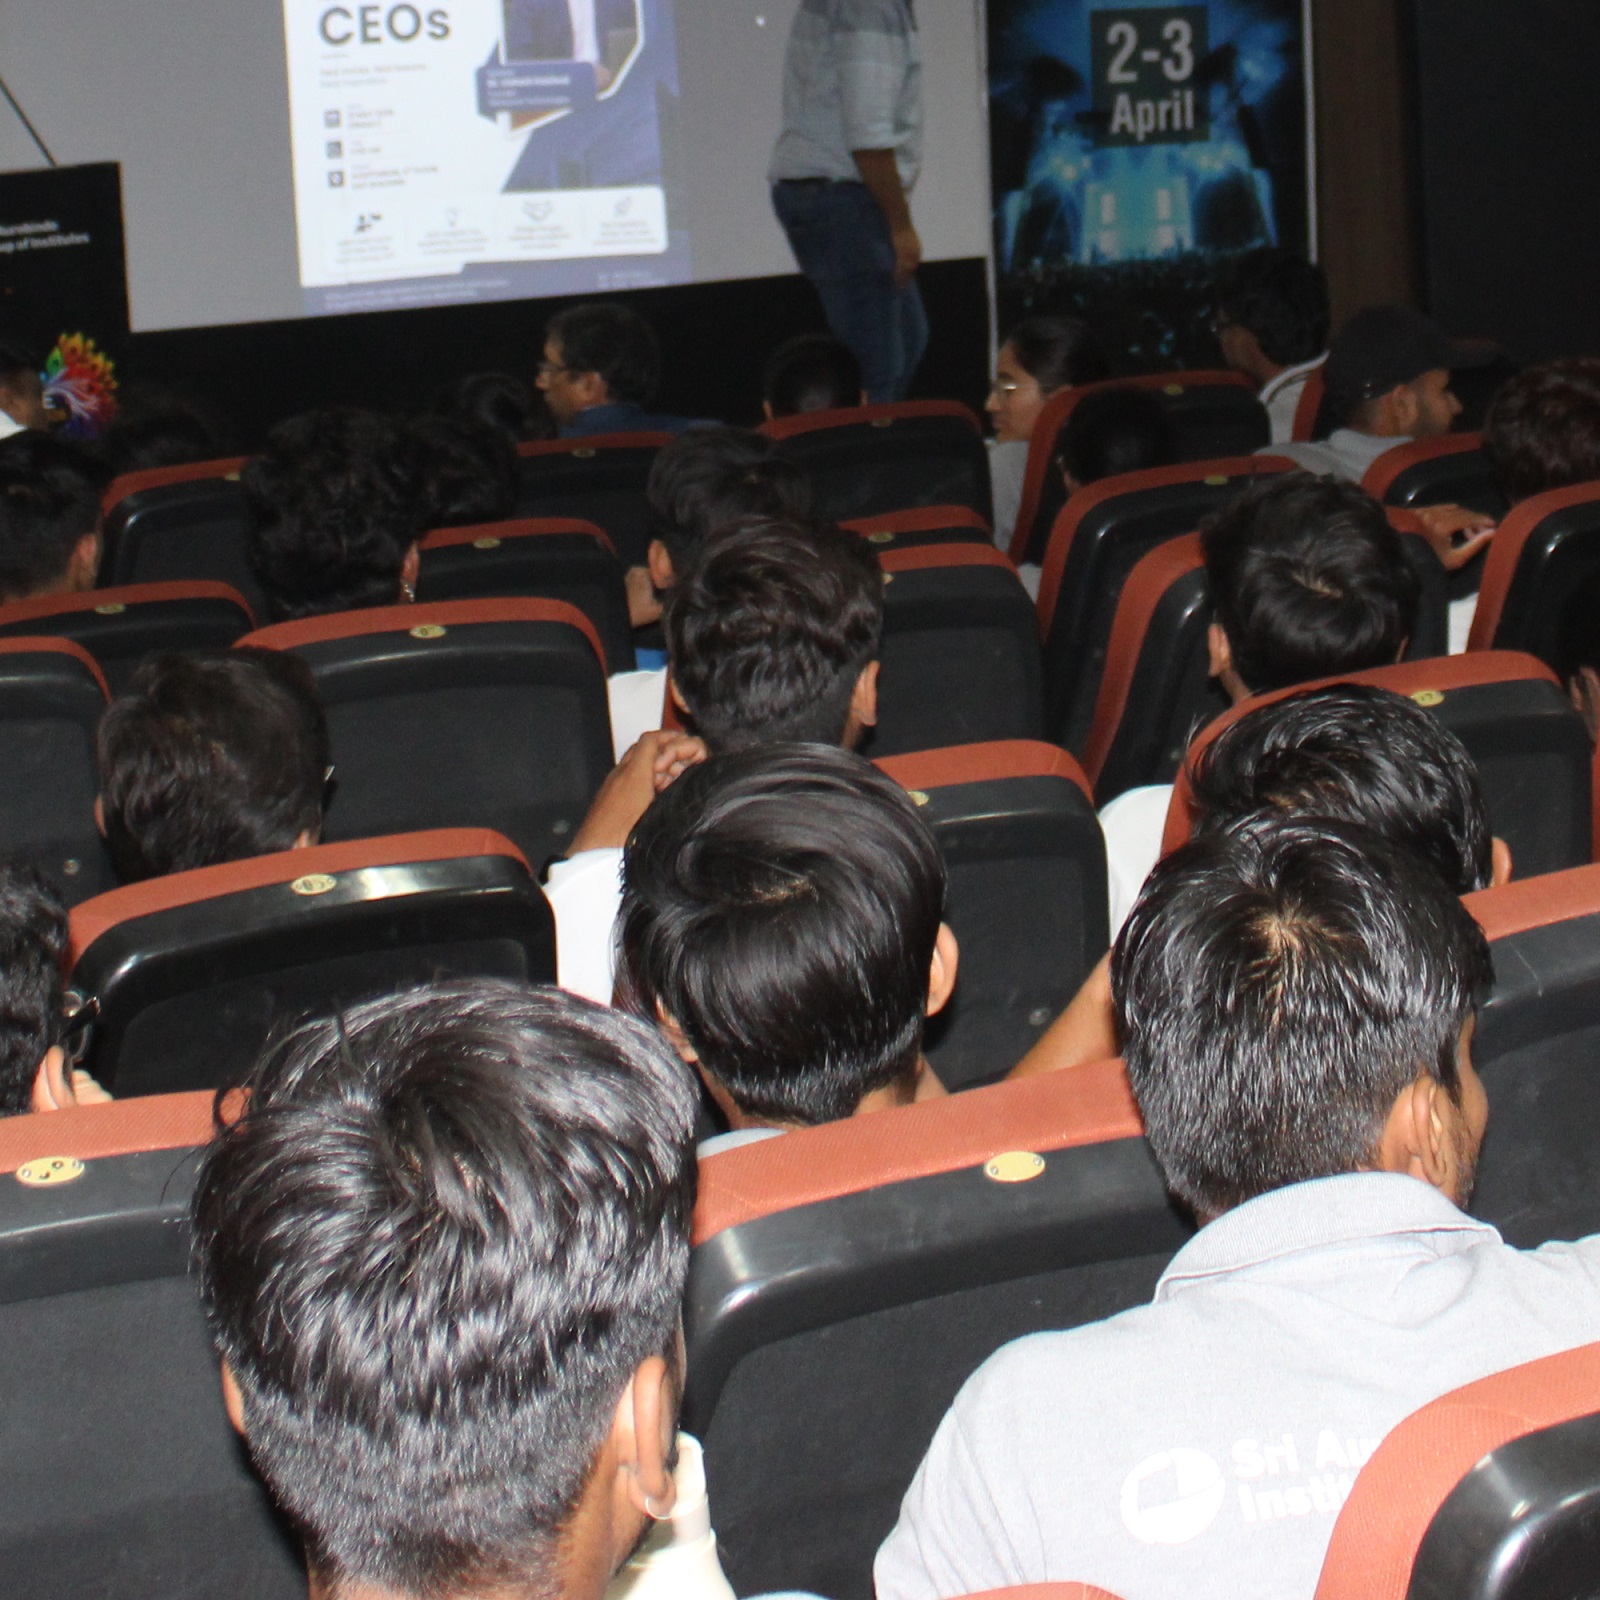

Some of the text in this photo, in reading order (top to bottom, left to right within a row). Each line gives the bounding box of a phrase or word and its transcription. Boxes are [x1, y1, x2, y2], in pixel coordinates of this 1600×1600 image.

[318, 3, 452, 46] CEOs
[1106, 18, 1194, 84] 2-3
[1110, 90, 1194, 142] April
[1231, 1433, 1300, 1479] Sri
